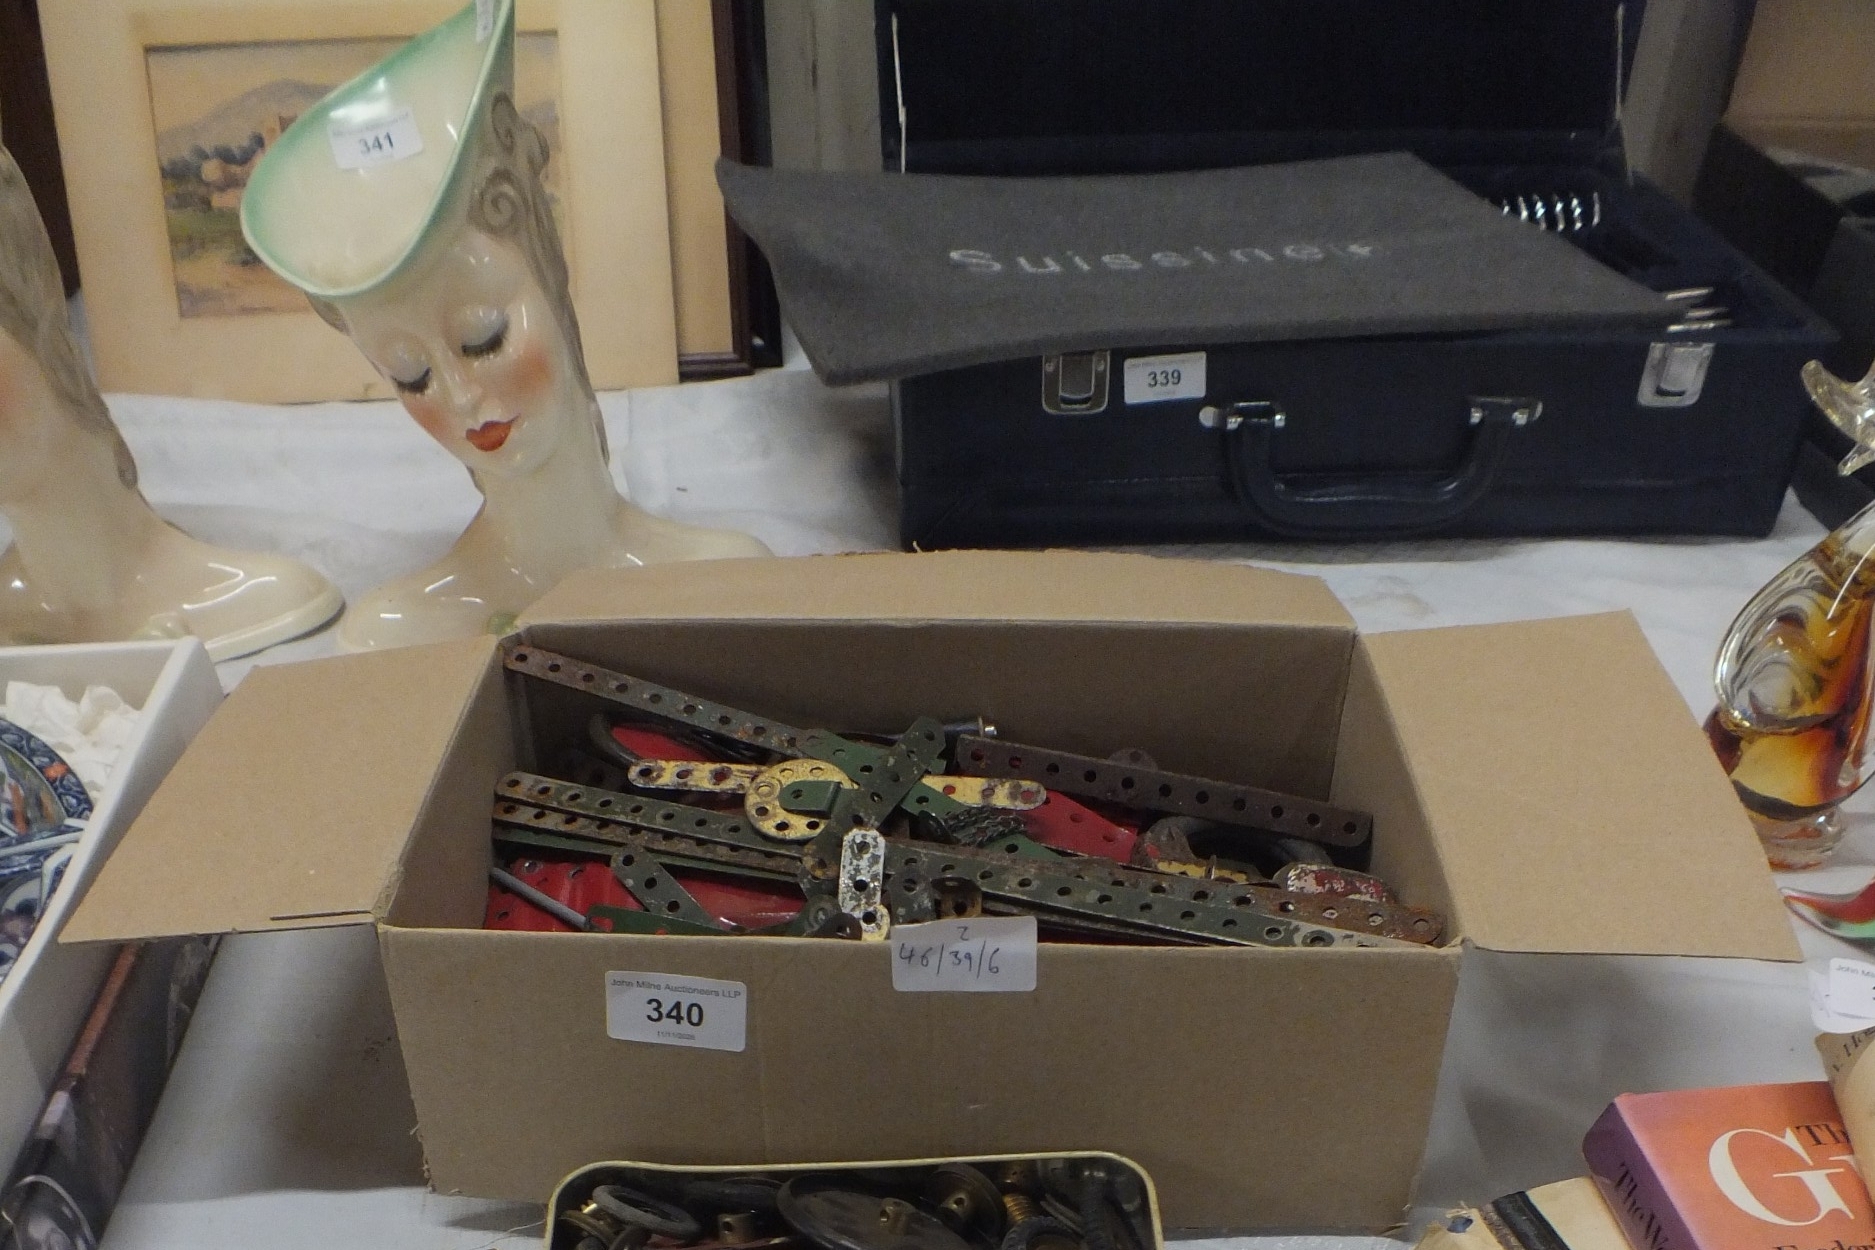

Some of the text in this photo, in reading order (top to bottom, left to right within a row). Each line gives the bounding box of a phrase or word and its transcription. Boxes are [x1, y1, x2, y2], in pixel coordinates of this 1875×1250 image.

[359, 132, 394, 154] 341
[1147, 368, 1182, 388] 339
[610, 978, 741, 999] John Milne Auctioneers LLP
[646, 998, 704, 1027] 340
[1708, 1127, 1856, 1227] G
[1614, 1161, 1644, 1220] The
